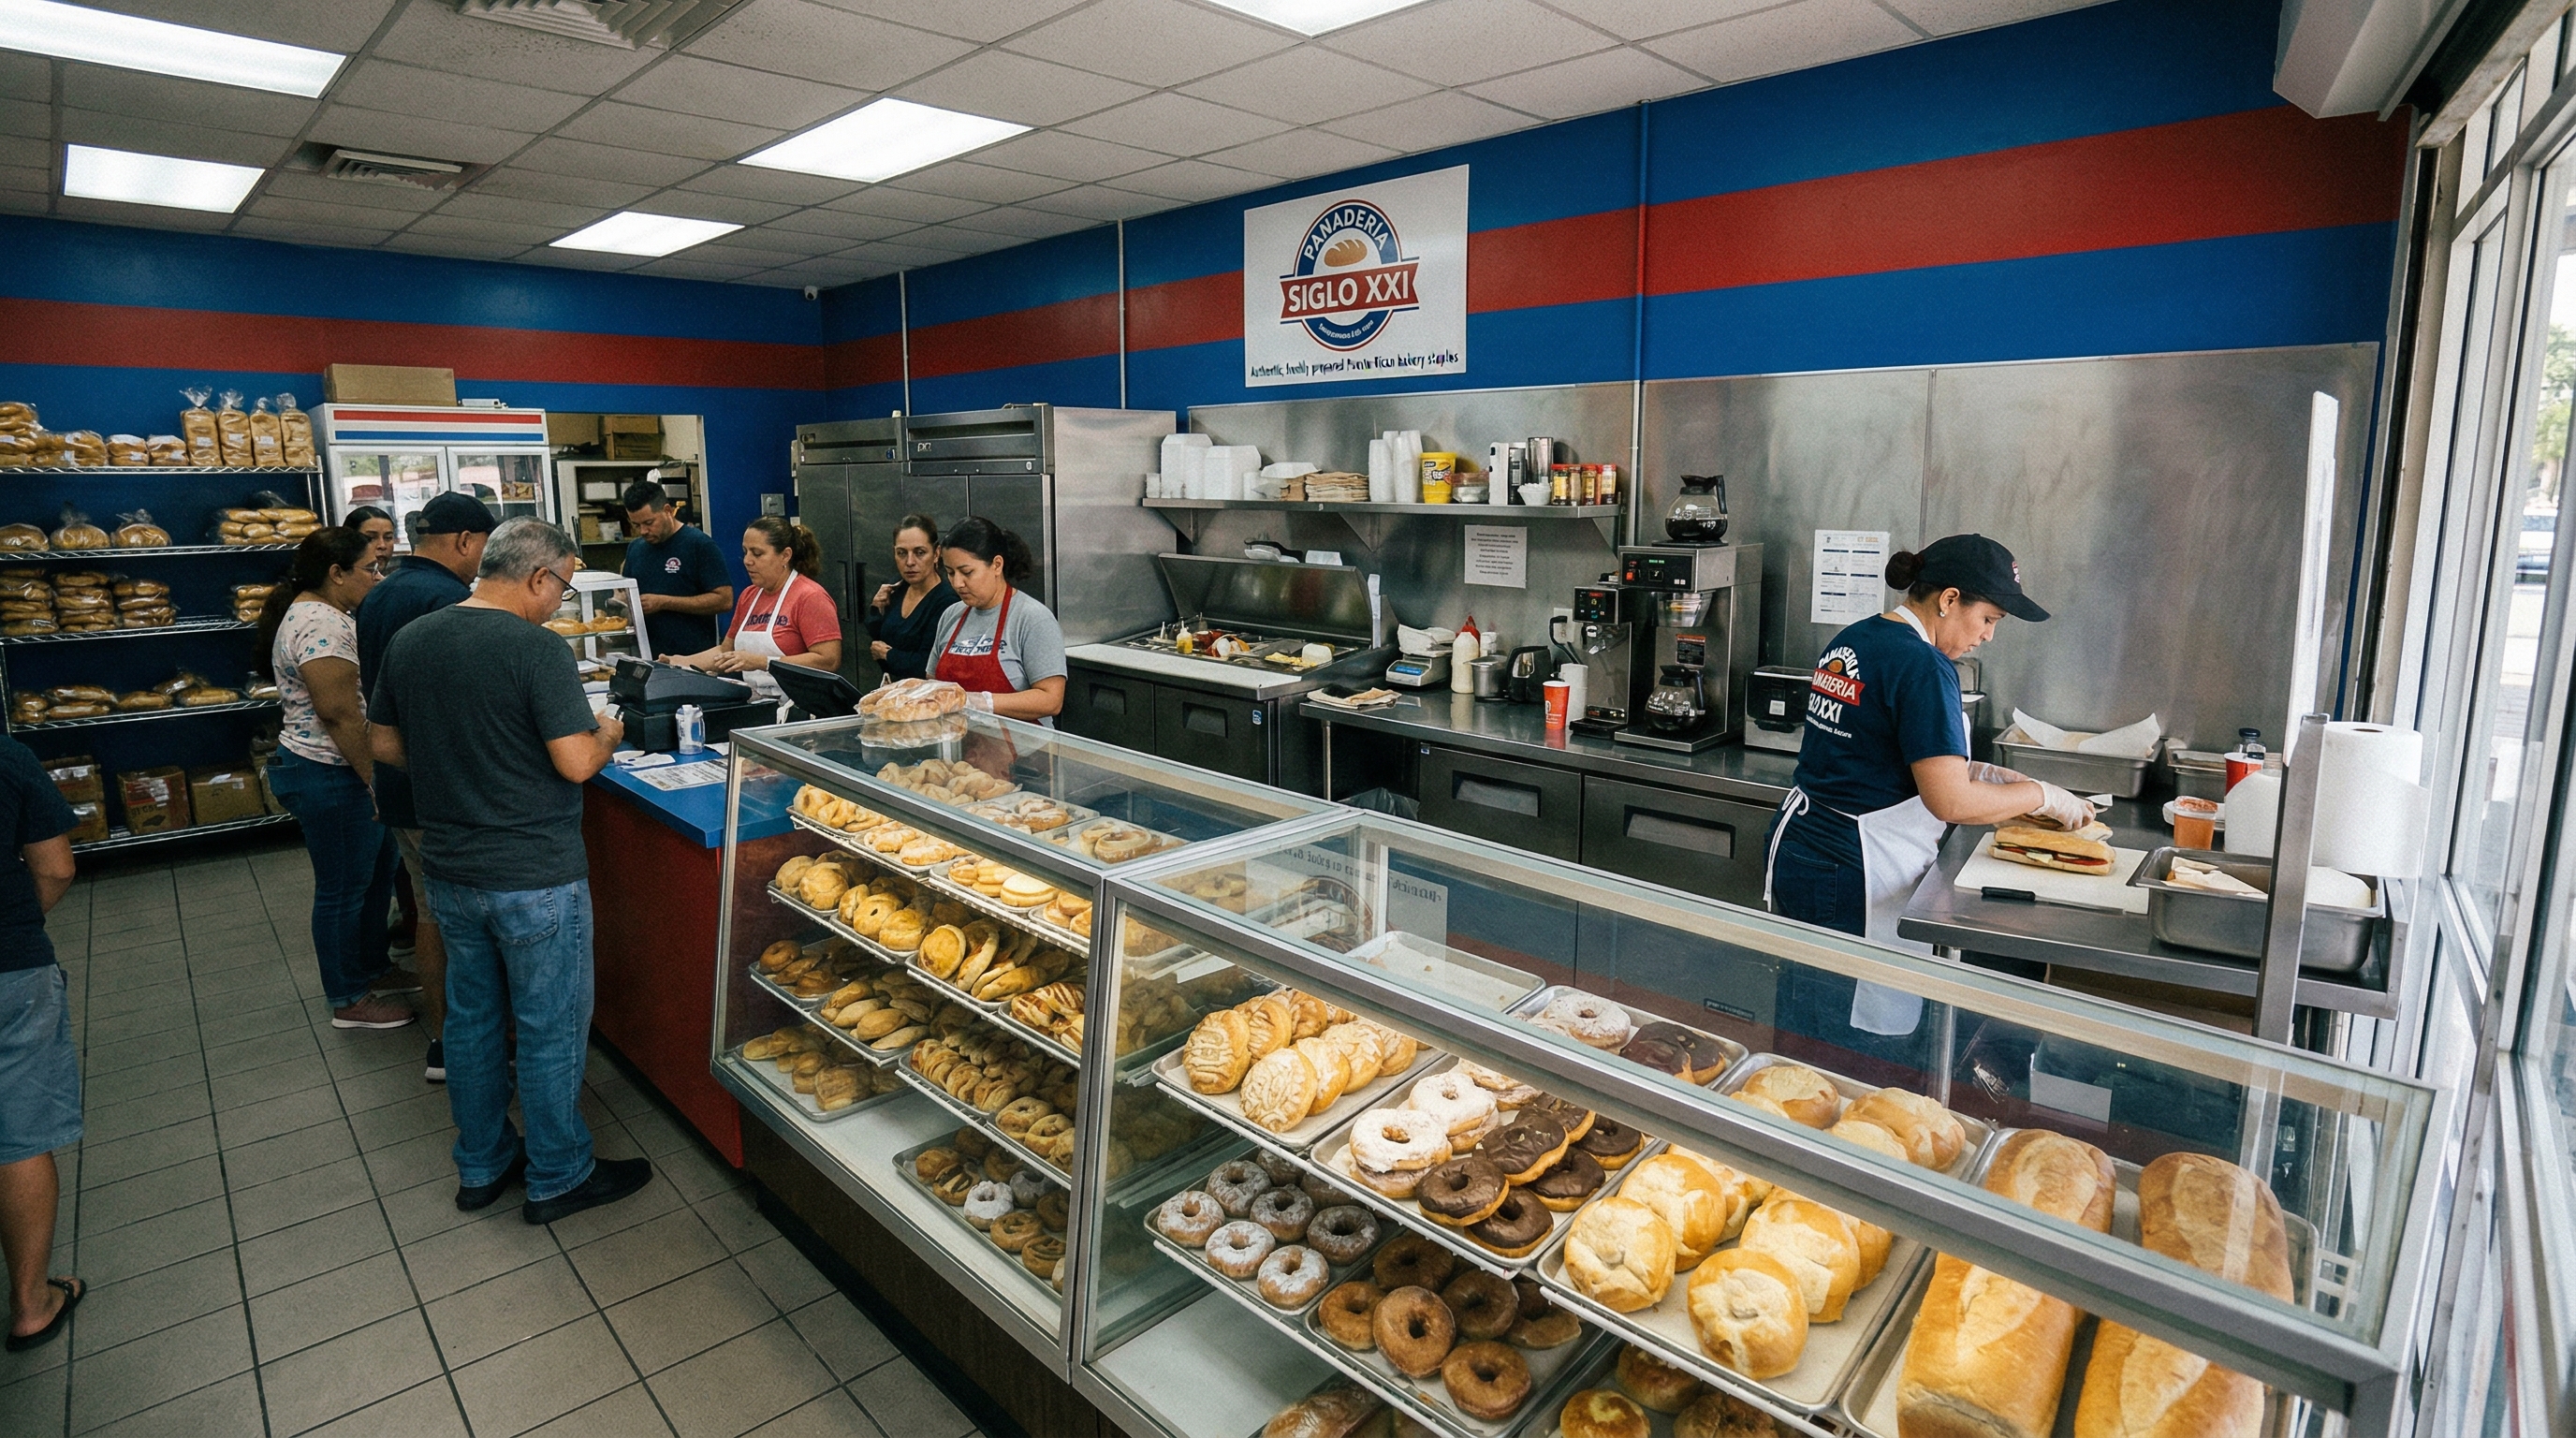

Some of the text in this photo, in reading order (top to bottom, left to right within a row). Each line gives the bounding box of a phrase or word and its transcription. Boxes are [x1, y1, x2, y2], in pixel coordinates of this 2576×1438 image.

[1288, 271, 1409, 313] SIGLO XXI
[1817, 697, 1843, 724] XXI
